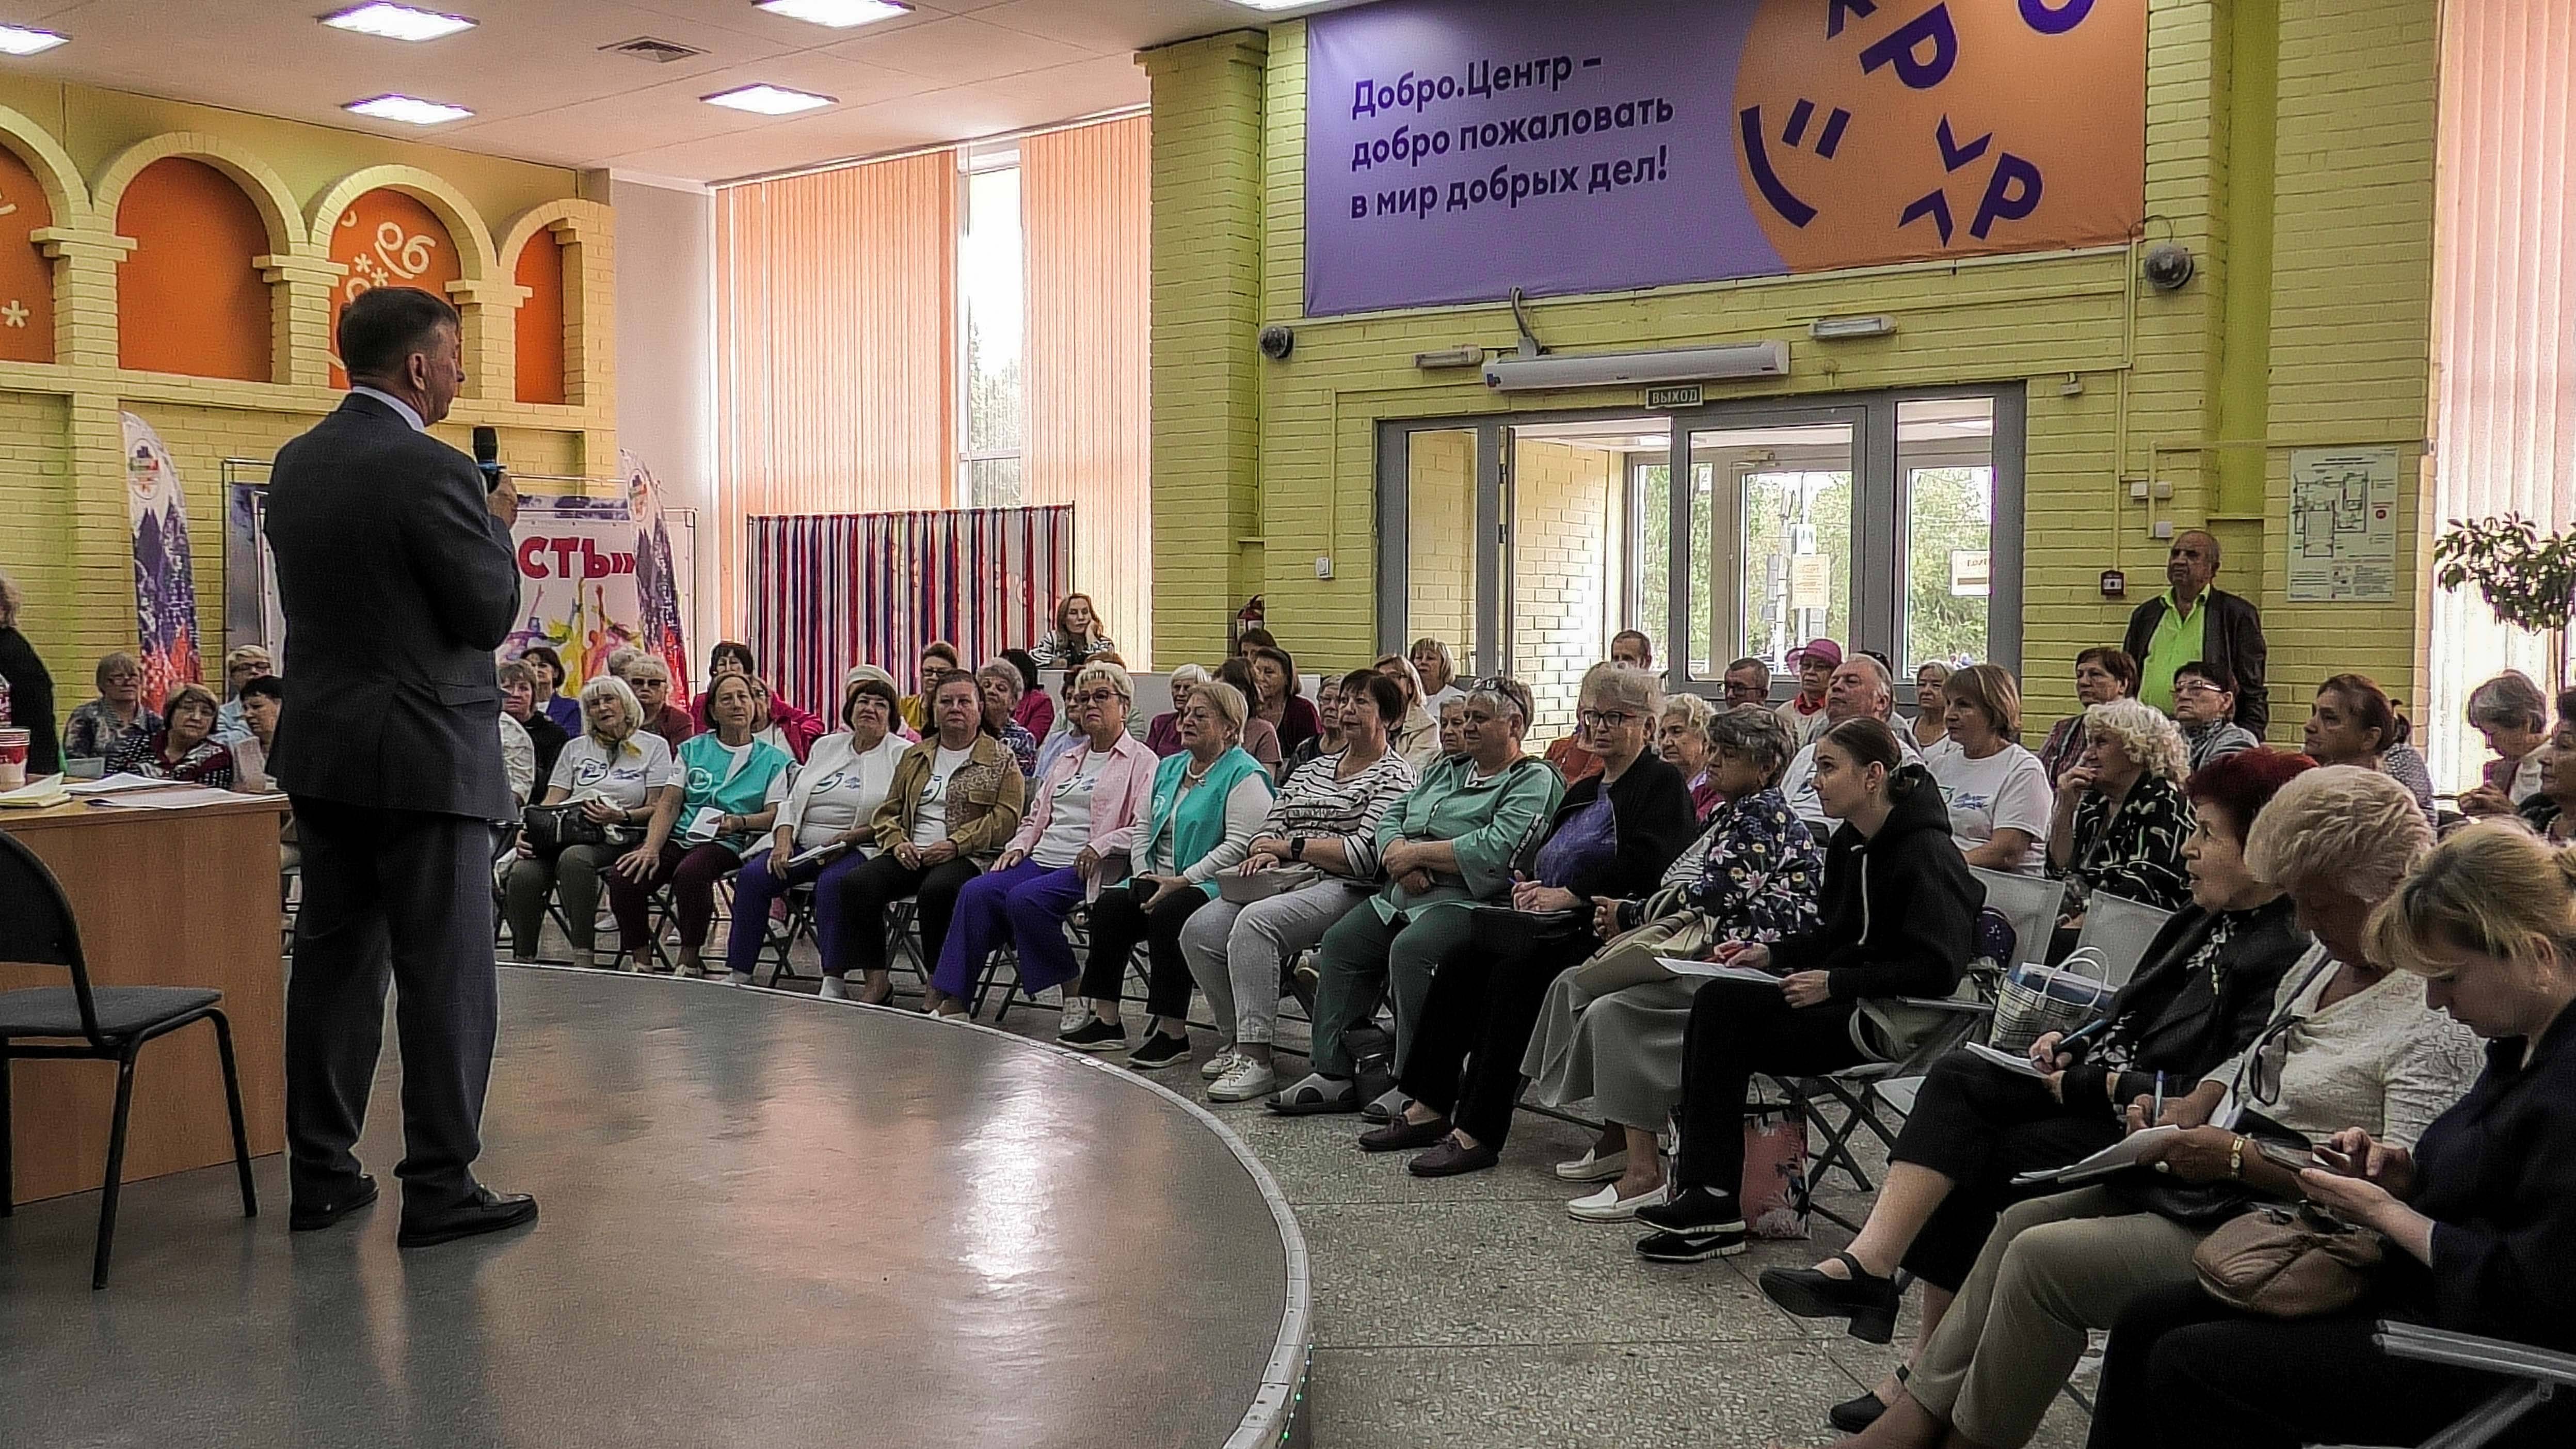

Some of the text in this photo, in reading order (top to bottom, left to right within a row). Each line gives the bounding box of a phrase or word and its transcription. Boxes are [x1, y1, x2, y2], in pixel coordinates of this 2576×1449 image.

[1351, 55, 1572, 119] Добро.Центр
[1351, 97, 1674, 171] добро пожаловать
[1351, 145, 1668, 219] в мир добрых дел!
[1653, 389, 1697, 404] ВЫХОД
